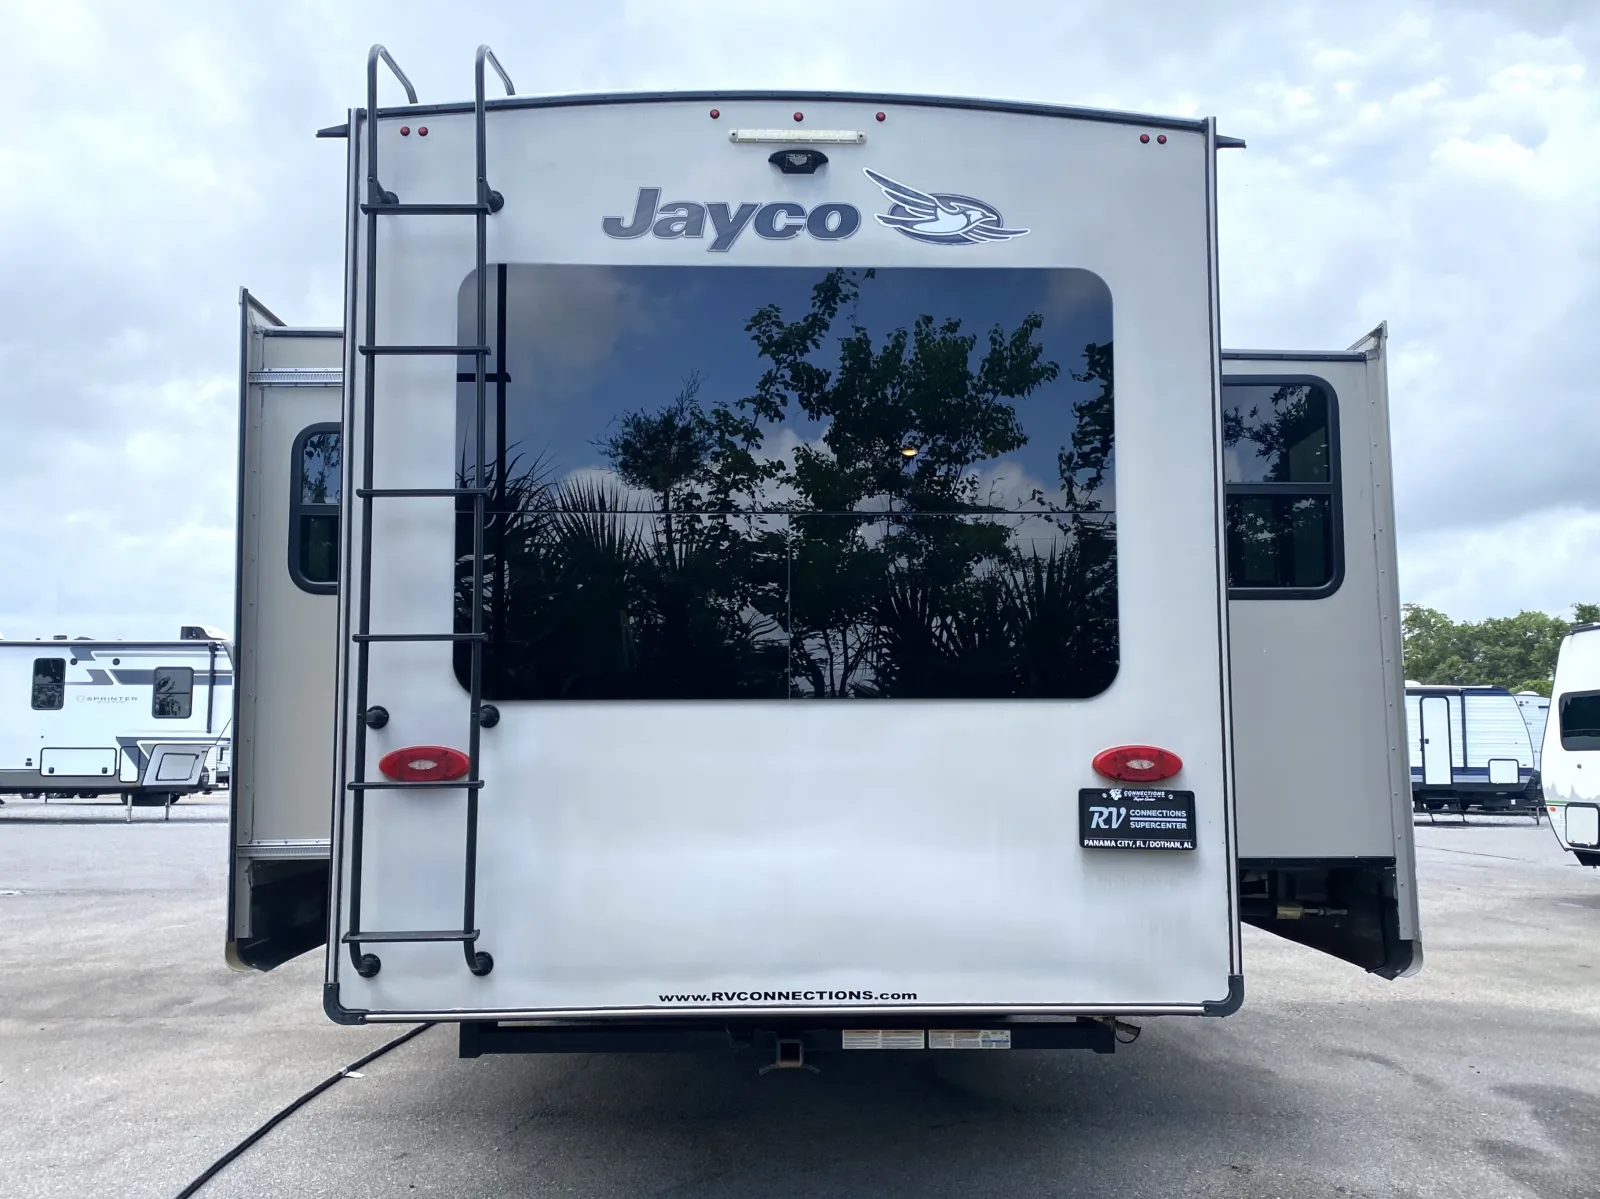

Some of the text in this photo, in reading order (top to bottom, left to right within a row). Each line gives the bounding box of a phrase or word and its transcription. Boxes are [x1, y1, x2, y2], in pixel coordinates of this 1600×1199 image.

[602, 187, 862, 252] Jayco
[1089, 806, 1127, 829] RV
[1129, 809, 1187, 817] CONNECTIONS
[1129, 821, 1188, 830] SUPERCENTER
[1084, 839, 1116, 847] PANAMA
[1117, 840, 1136, 848] CITY,
[1149, 840, 1182, 849] DOTHAN,
[1183, 841, 1193, 849] AL
[658, 990, 918, 1002] www.RVCONNECTIONS.com
